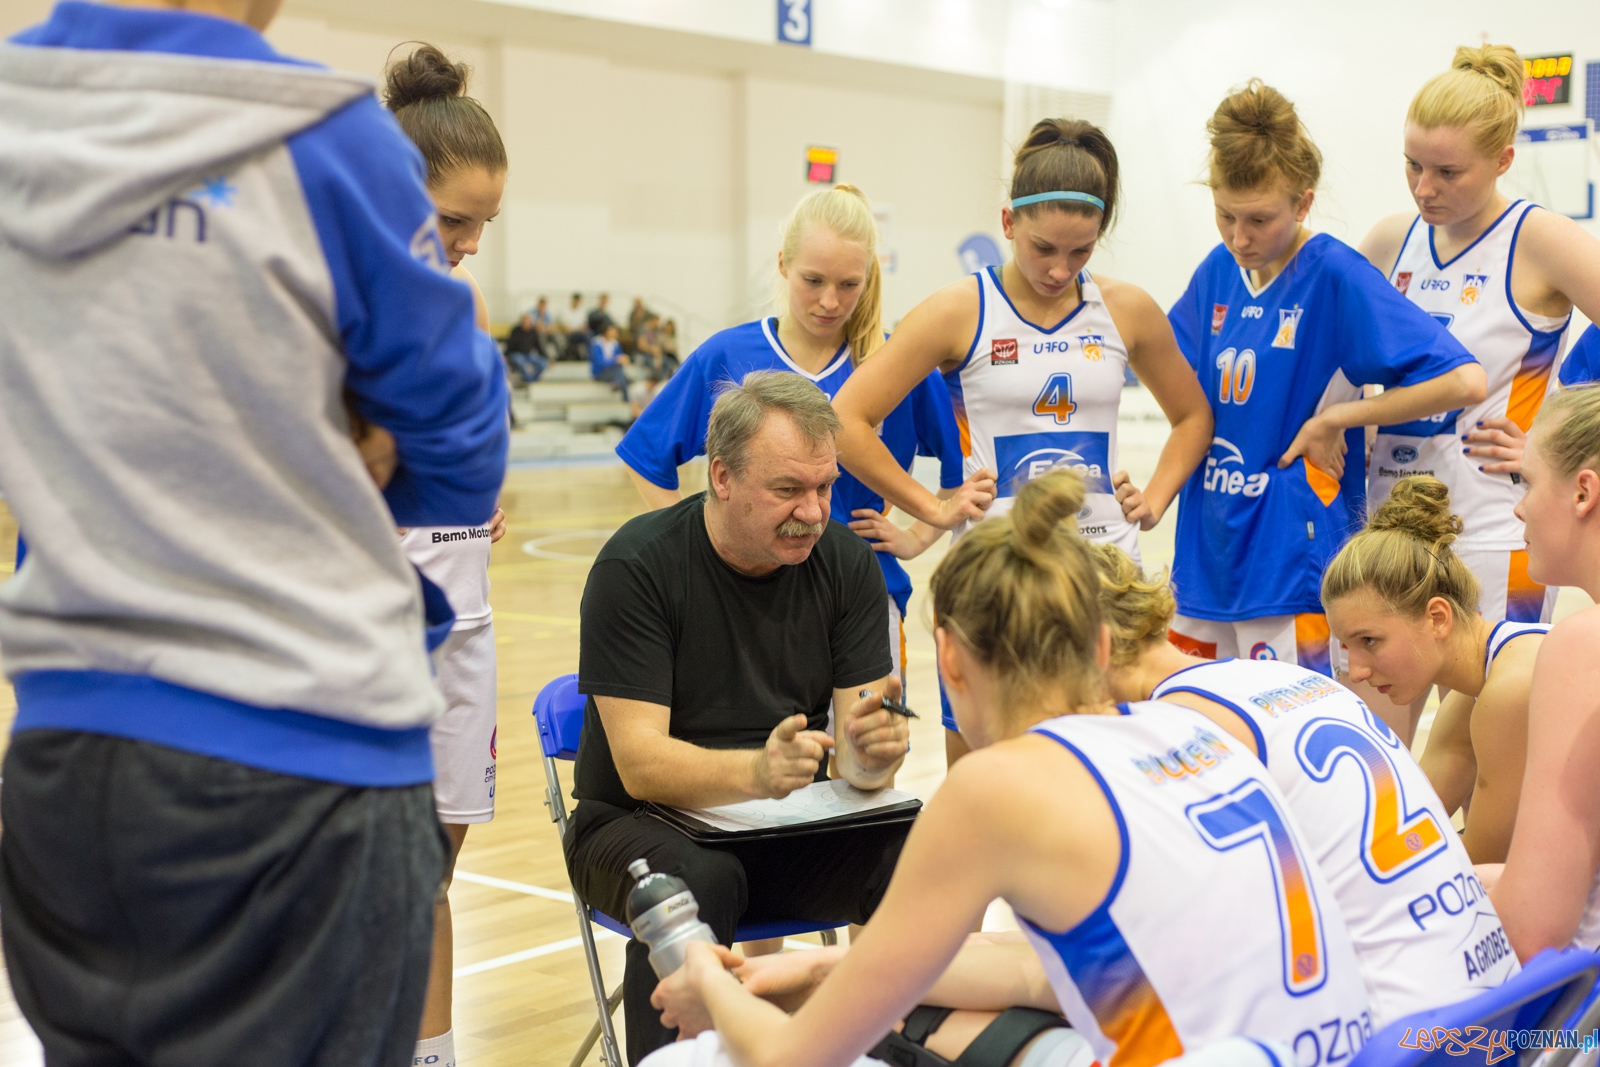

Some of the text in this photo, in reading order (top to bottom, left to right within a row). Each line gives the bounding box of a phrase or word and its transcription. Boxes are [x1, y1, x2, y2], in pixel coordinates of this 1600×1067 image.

[782, 0, 809, 42] 3
[1032, 372, 1077, 425] 4
[1216, 347, 1256, 405] 10
[1203, 456, 1269, 498] Enea
[431, 527, 491, 543] Bemo Motor
[1294, 701, 1448, 884] 2
[1184, 777, 1328, 998] 7
[1463, 926, 1514, 981] AGROBE
